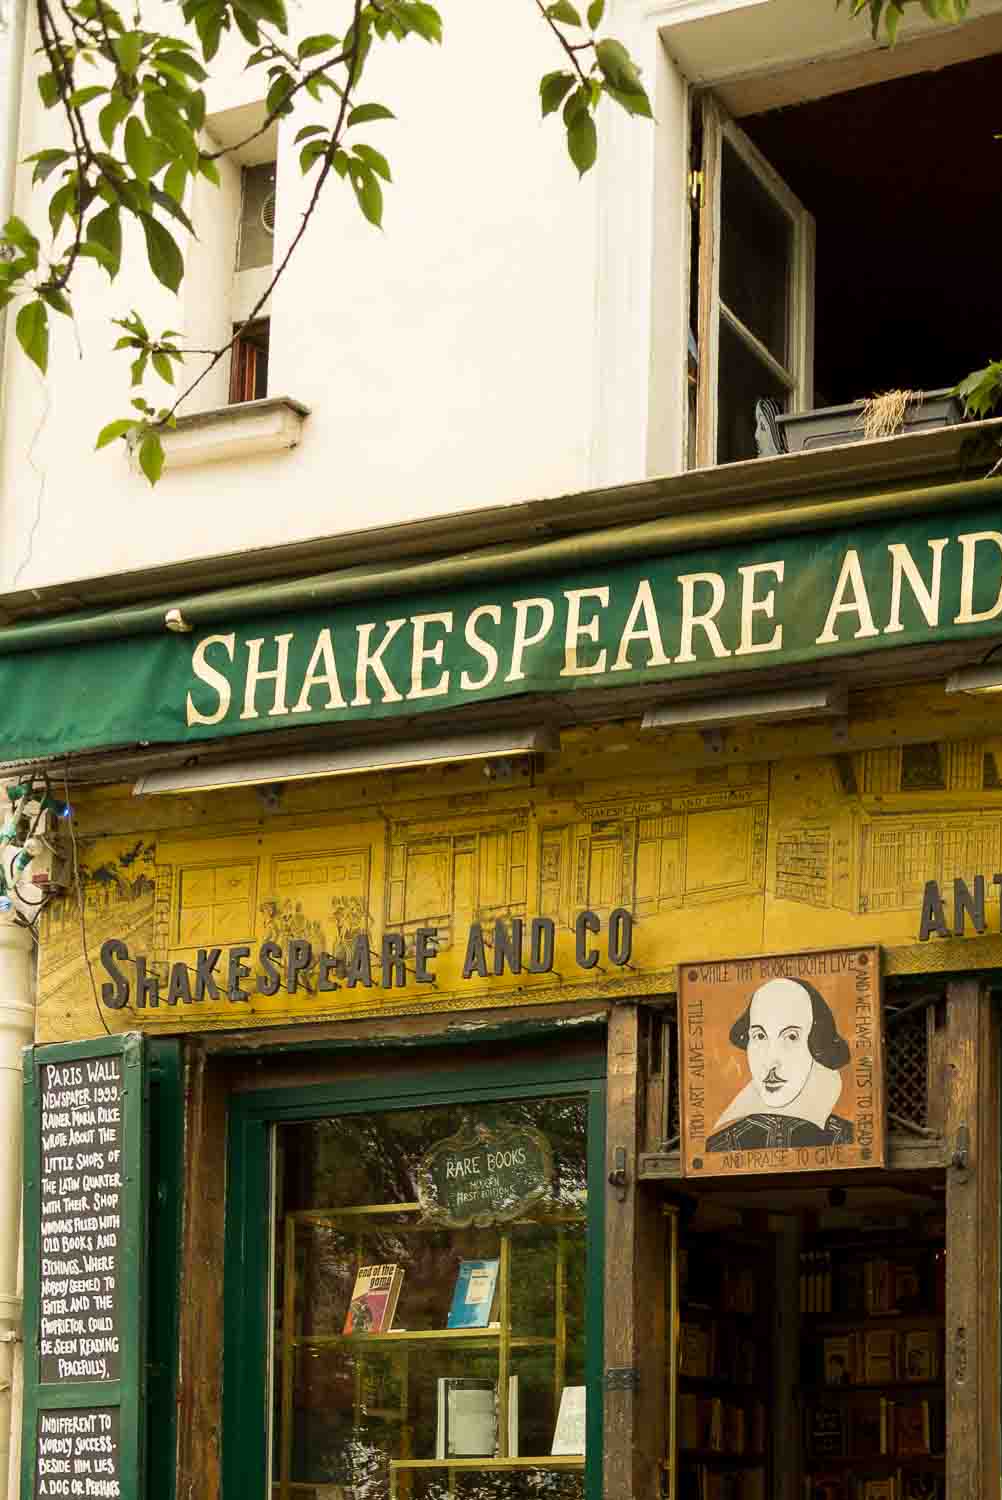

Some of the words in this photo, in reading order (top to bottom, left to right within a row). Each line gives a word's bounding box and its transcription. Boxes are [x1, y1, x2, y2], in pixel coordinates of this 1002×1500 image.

[186, 559, 784, 727] SHAKESPEARE
[463, 917, 554, 978] AND
[575, 908, 634, 969] CO
[700, 963, 729, 984] WHILE
[831, 952, 857, 973] LIVE
[855, 994, 873, 1012] WE
[687, 999, 704, 1036] STILL
[855, 1016, 873, 1049] HAVE
[687, 1040, 705, 1078] ALIVE
[46, 1064, 83, 1090] PARIS
[86, 1060, 121, 1083] WALL
[856, 1057, 874, 1088] WITS
[42, 1087, 93, 1111] NEWSPAPER
[687, 1084, 705, 1109] ART
[857, 1095, 873, 1109] TO
[97, 1106, 121, 1124] RILKE
[856, 1114, 874, 1146] READ
[44, 1156, 75, 1174] LITTLE
[75, 1151, 105, 1171] SHOPS
[107, 1149, 121, 1163] OF
[446, 1156, 481, 1179] RARE
[487, 1147, 526, 1172] BOOKS
[747, 1149, 788, 1168] PRAISE
[797, 1146, 809, 1166] TO
[815, 1144, 842, 1164] GIVE
[41, 1177, 57, 1195] THE
[58, 1176, 81, 1196] LATIN
[82, 1172, 124, 1193] QUARTER
[358, 1267, 372, 1279] end
[372, 1266, 381, 1278] of
[381, 1265, 394, 1277] the
[369, 1276, 392, 1289] game
[97, 1413, 112, 1433] TO
[38, 1457, 71, 1476] BESIDE
[93, 1457, 115, 1475] LIES
